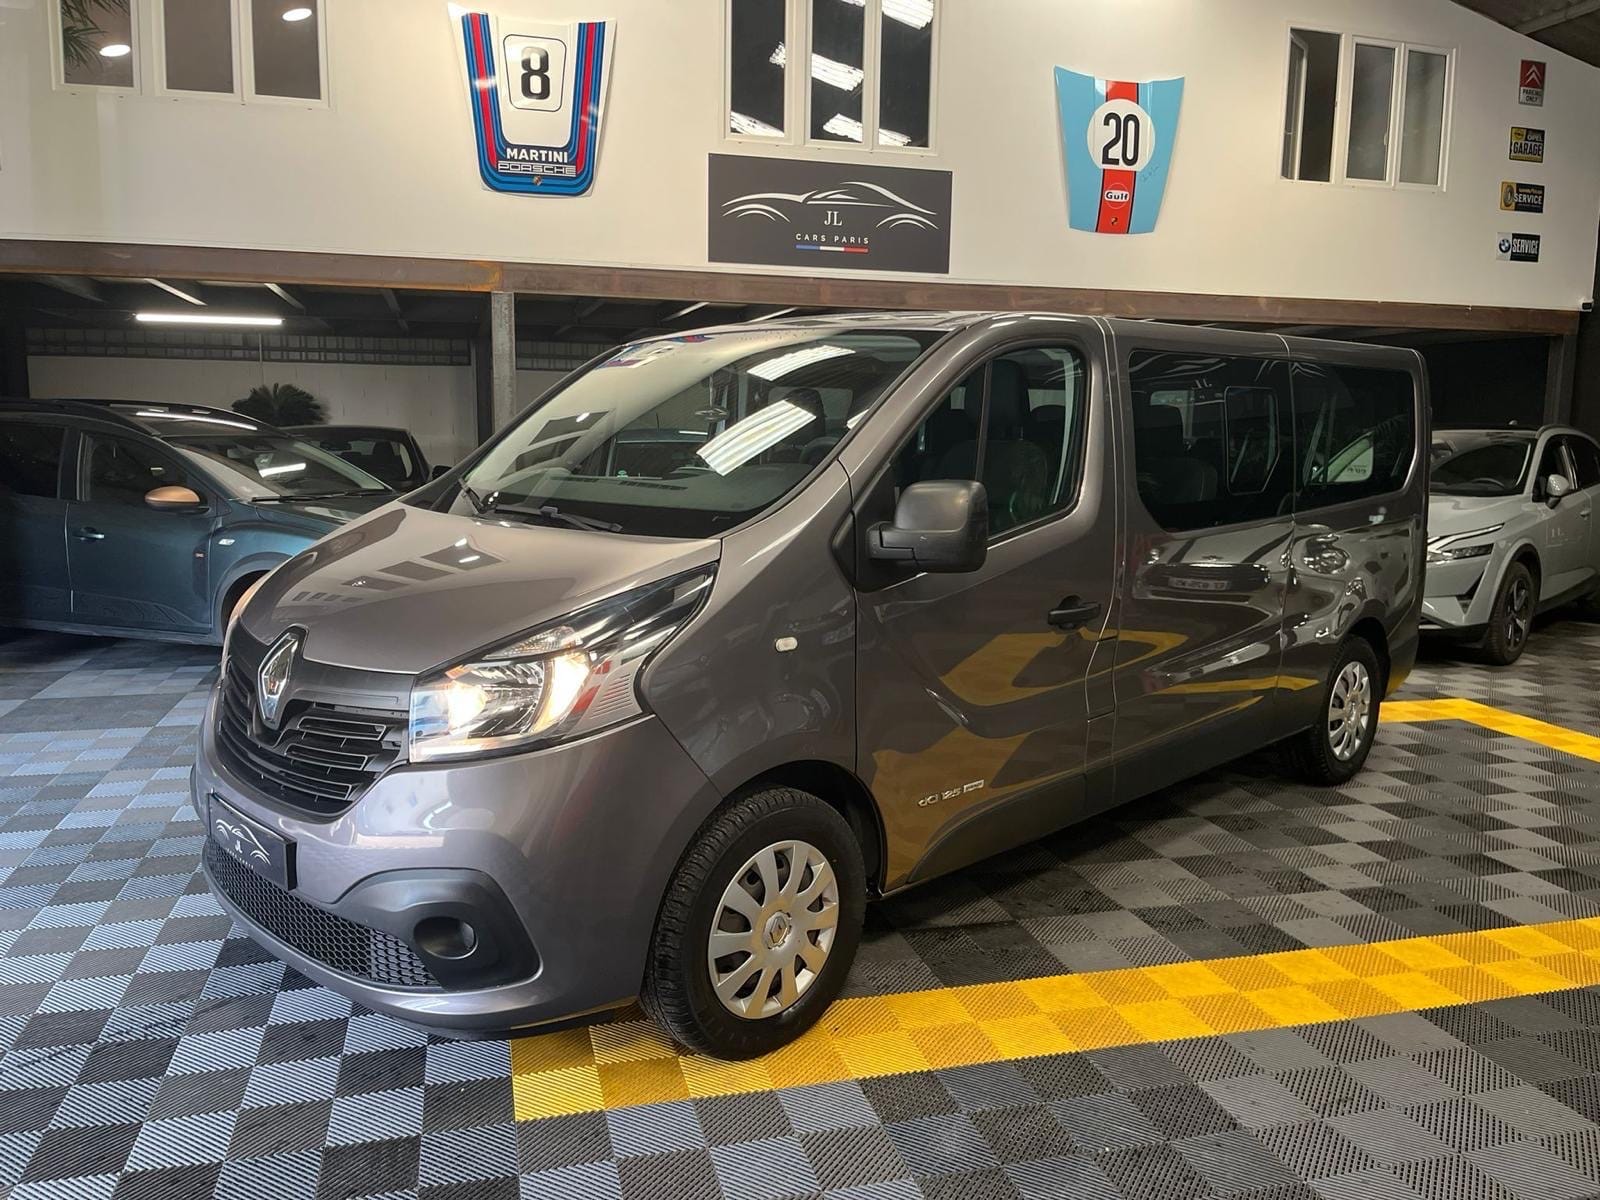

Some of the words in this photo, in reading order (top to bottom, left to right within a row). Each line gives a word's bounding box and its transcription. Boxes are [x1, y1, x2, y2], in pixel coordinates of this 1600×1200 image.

[521, 46, 551, 100] 8
[1101, 112, 1140, 167] 20
[506, 147, 568, 164] MARTINI
[1513, 141, 1542, 156] GARAGE
[497, 160, 577, 178] PORSCHE
[1105, 190, 1129, 201] Gulf
[1513, 193, 1543, 205] SERVICE
[823, 210, 843, 226] JL
[795, 233, 826, 242] CARS
[834, 235, 869, 245] PARIS
[1512, 238, 1539, 254] SERVICE
[941, 788, 962, 801] 125
